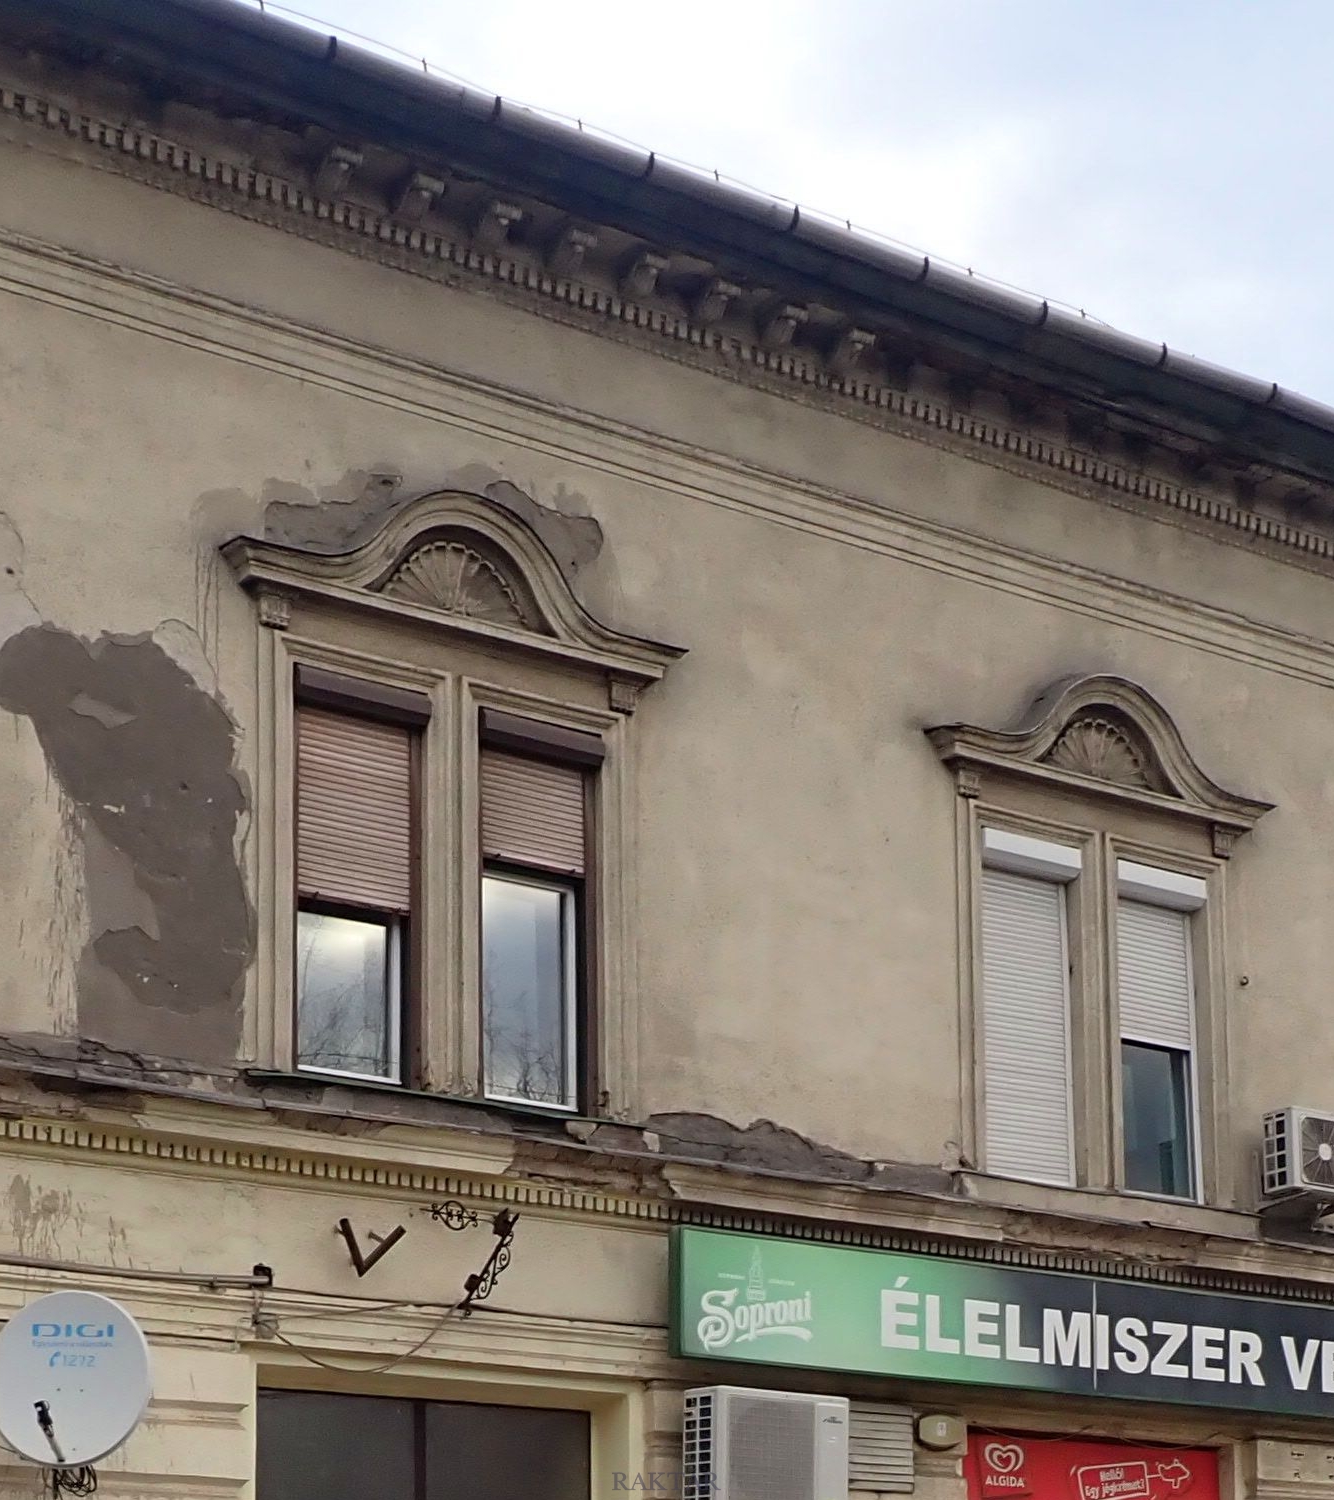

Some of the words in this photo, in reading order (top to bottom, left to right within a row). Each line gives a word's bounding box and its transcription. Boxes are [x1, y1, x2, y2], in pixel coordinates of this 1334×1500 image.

[31, 1324, 115, 1338] DIGI
[697, 1288, 813, 1352] Soproni
[880, 1277, 1265, 1386] ÉLELMISZER
[985, 1475, 1025, 1488] ALGIDA
